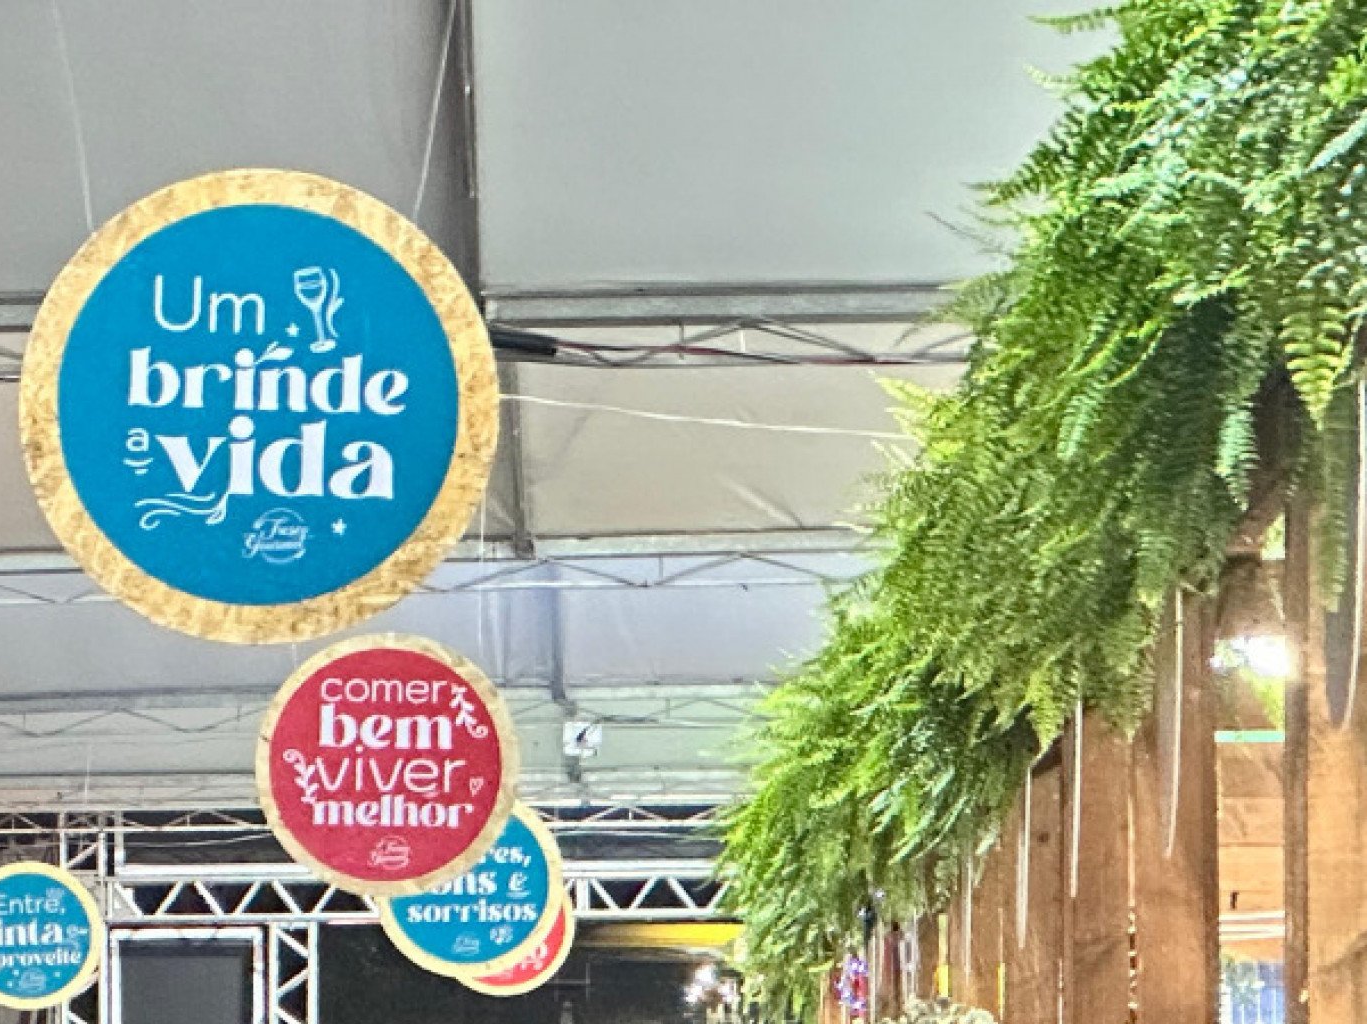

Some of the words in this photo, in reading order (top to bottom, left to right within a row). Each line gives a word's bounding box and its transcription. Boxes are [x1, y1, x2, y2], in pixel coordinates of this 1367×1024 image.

[153, 273, 266, 335] Um
[127, 346, 409, 416] brinde
[125, 426, 150, 453] a
[154, 415, 395, 500] vida
[320, 677, 449, 704] comer
[318, 704, 453, 750] bem
[314, 745, 466, 793] viver
[313, 795, 474, 829] melhor
[406, 898, 538, 923] sorrisos
